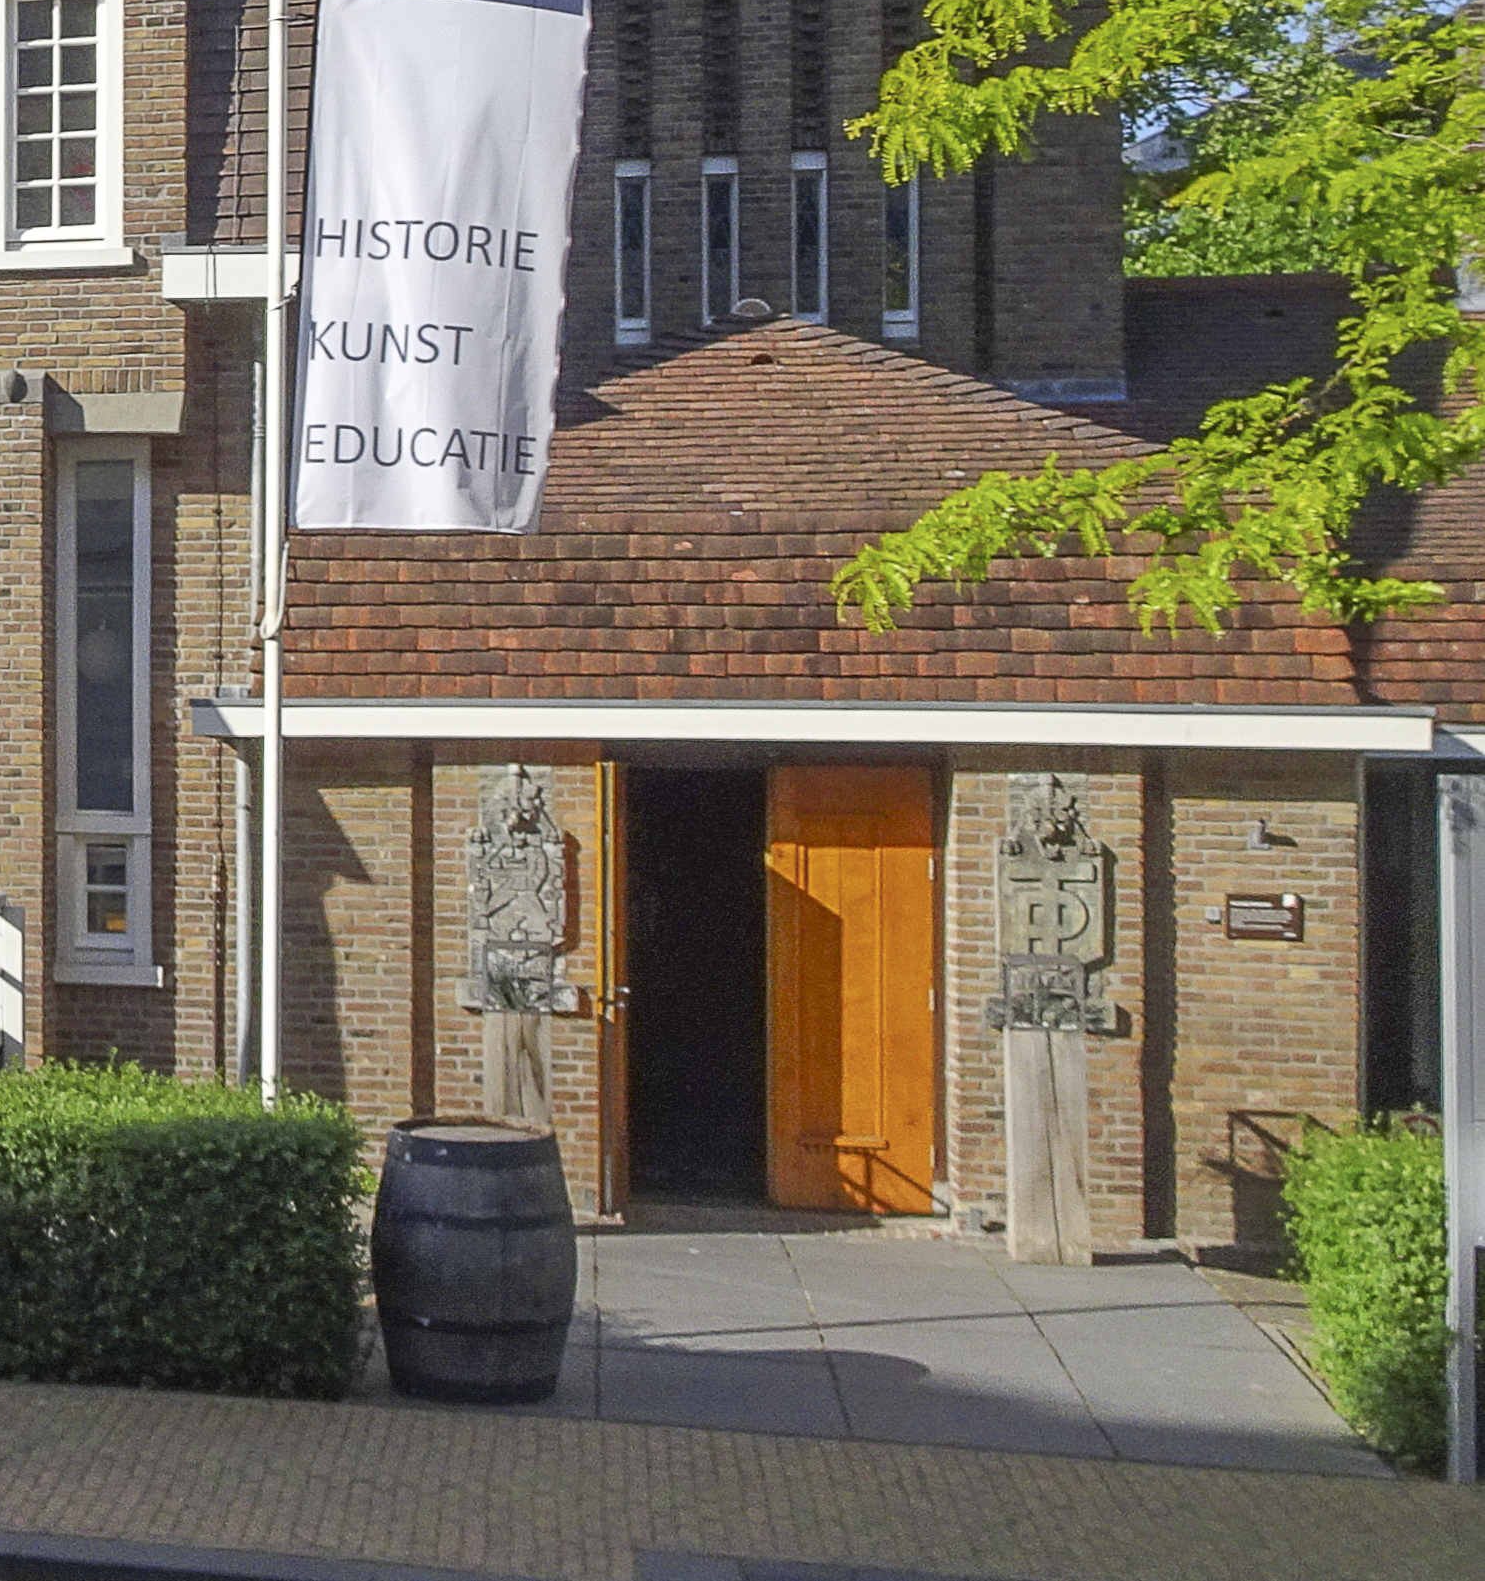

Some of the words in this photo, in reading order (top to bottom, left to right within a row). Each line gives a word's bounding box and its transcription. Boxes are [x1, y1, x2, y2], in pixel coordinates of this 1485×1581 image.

[316, 218, 539, 272] HISTORIE
[309, 320, 474, 365] KUNST
[304, 424, 538, 476] EDUCATIE
